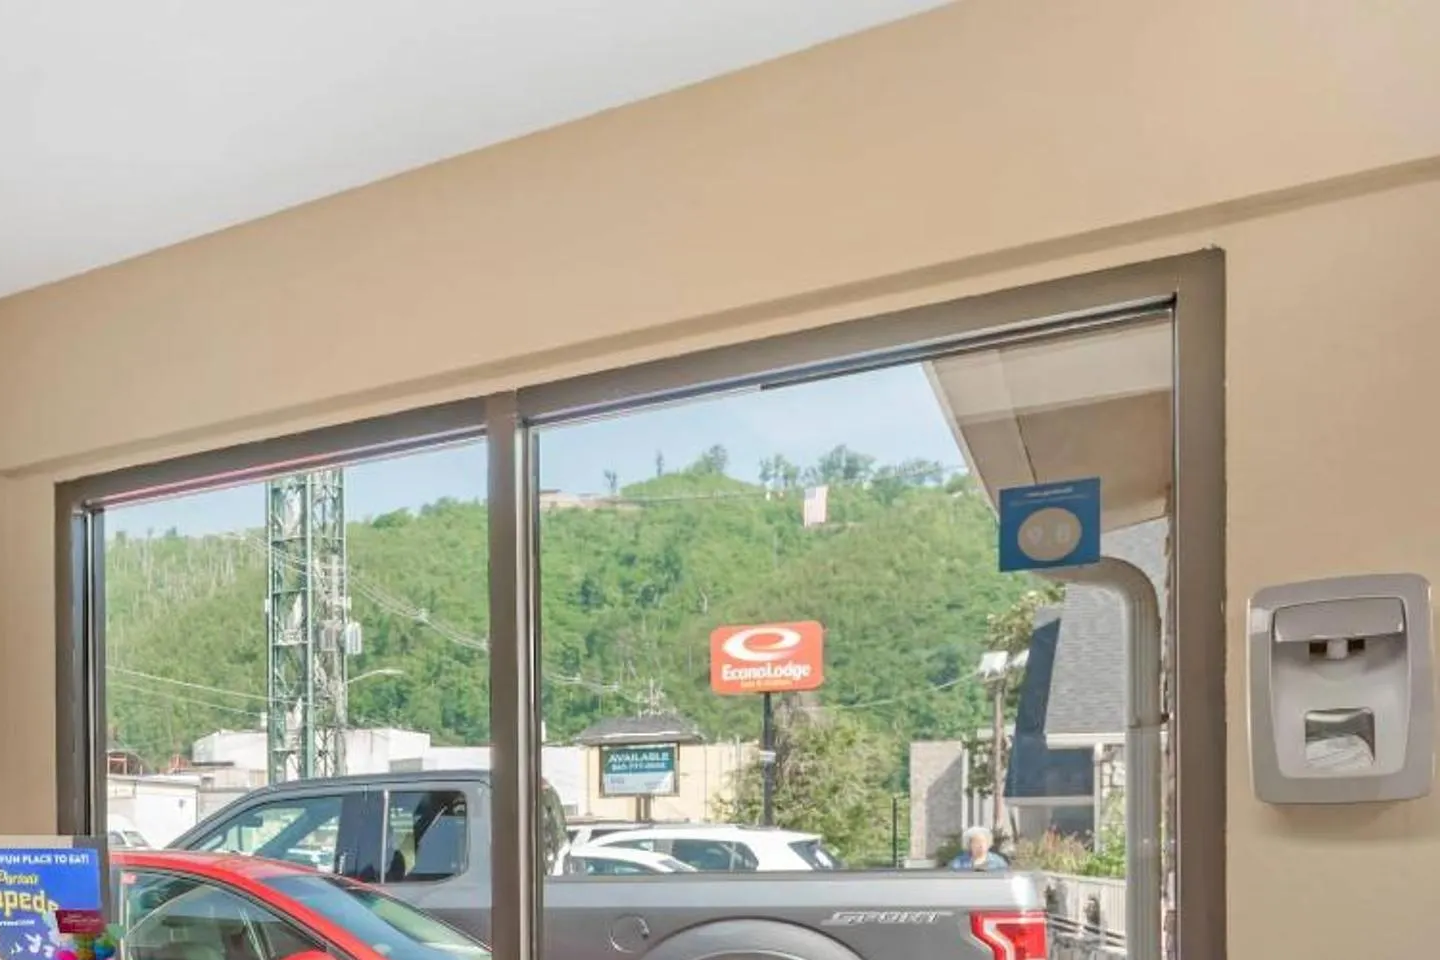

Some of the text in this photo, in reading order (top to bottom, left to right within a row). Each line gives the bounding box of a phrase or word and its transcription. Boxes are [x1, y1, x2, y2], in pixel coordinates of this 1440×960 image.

[608, 752, 670, 763] AVAILABLE
[0, 854, 20, 864] FUN
[22, 854, 53, 864] PLACE
[55, 854, 68, 864] TO
